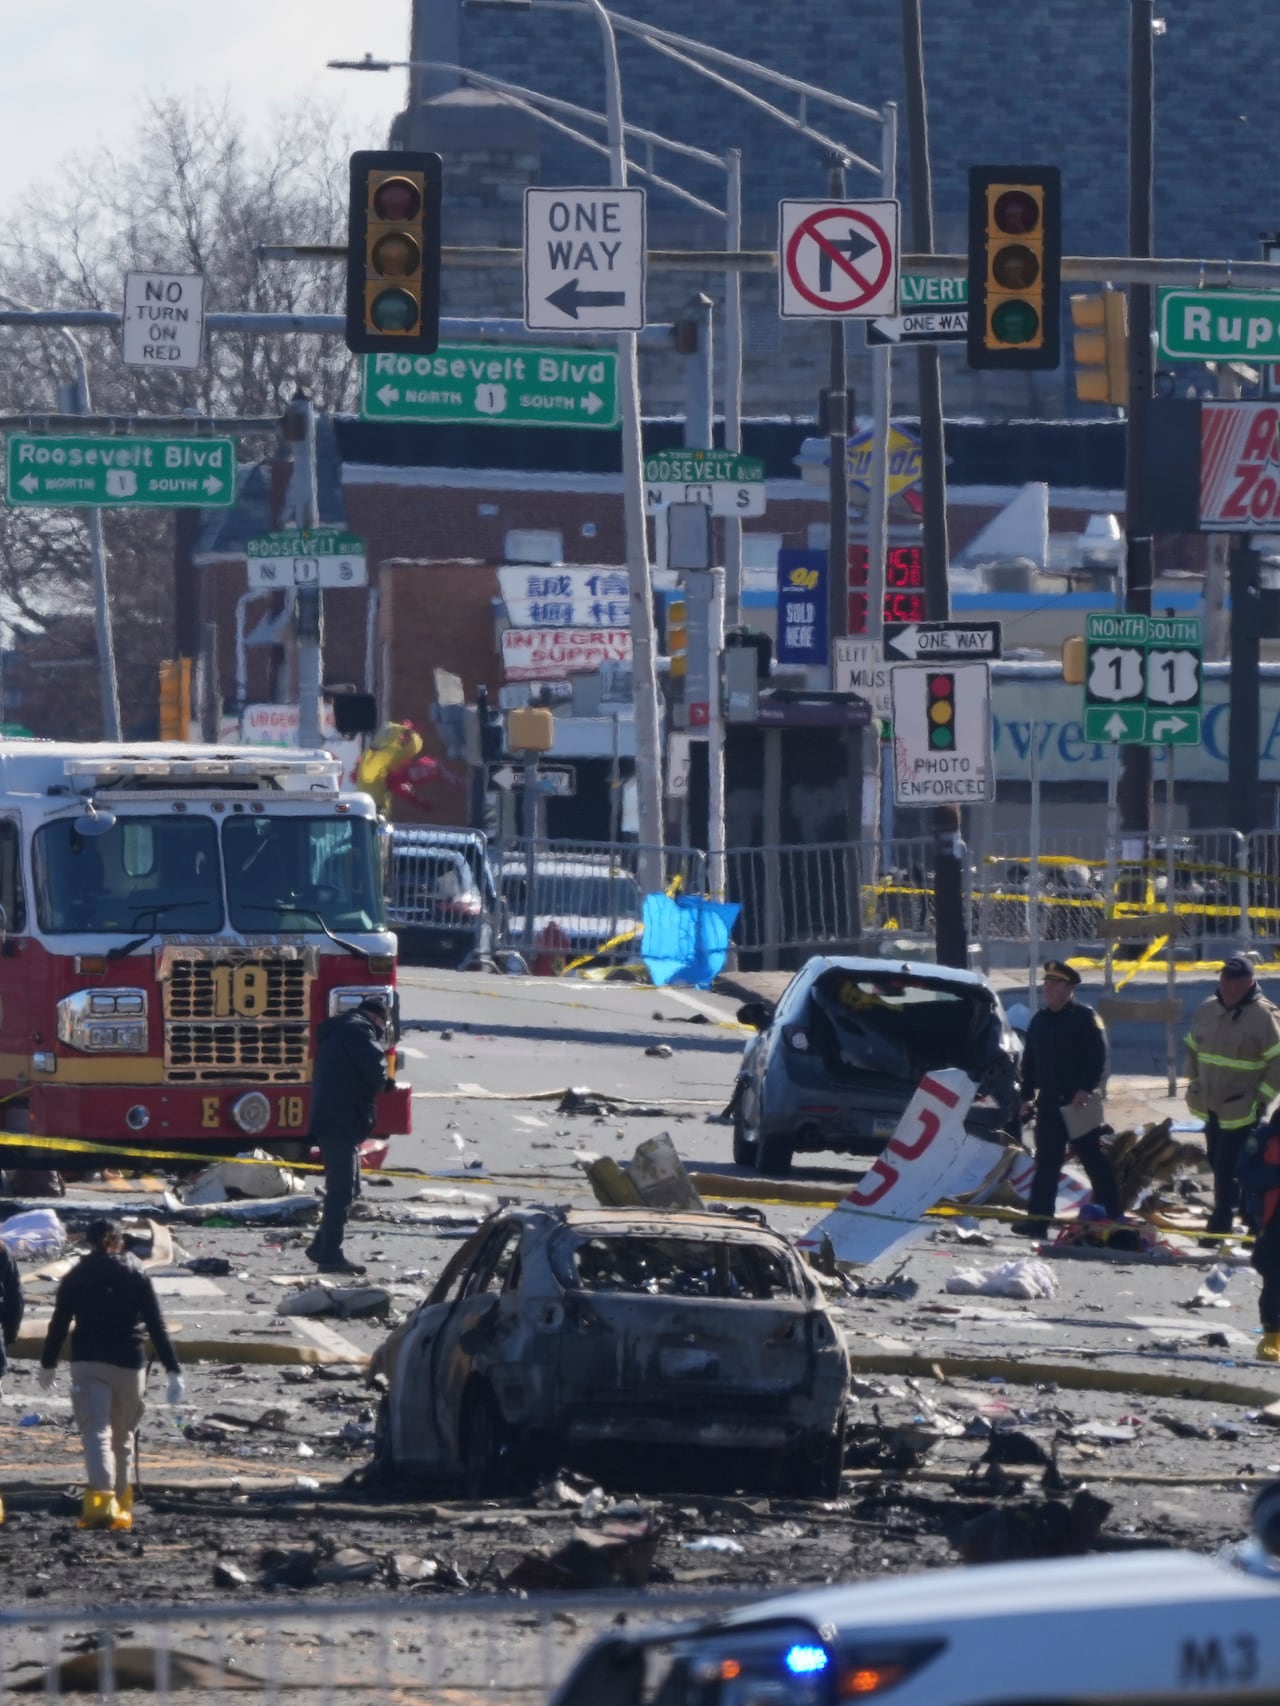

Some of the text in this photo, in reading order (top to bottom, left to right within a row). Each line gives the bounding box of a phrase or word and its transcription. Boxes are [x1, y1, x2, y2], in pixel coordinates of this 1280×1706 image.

[548, 201, 621, 233] ONE
[547, 241, 622, 271] WAY
[144, 279, 183, 304] NO
[900, 277, 967, 302] LVERT
[136, 305, 190, 322] TURN
[903, 315, 935, 332] ONE
[148, 323, 178, 342] ON
[1183, 305, 1280, 350] Rup
[143, 344, 182, 361] RED
[375, 352, 606, 384] Roosevelt Blvd
[405, 389, 462, 405] NORTH
[521, 393, 575, 410] SOUTH
[1241, 408, 1280, 462] A
[20, 443, 223, 468] Roosevelt Blvd
[646, 461, 733, 481] OOSEVELT
[45, 478, 95, 491] NORTH
[149, 478, 198, 491] SOUTH
[1219, 463, 1280, 519] Zo
[647, 489, 662, 506] N
[736, 489, 750, 508] S
[260, 563, 276, 580] N
[339, 561, 353, 581] S
[786, 602, 815, 623] SOLD
[1092, 618, 1144, 636] NORTH
[1149, 622, 1197, 639] SOUTH
[506, 631, 632, 648] INTEGRIT
[918, 632, 988, 650] ONE WAY
[531, 648, 627, 664] SUPPLY
[849, 669, 886, 688] MUS
[1108, 656, 1122, 690] 1
[1161, 659, 1175, 693] 1
[914, 757, 970, 773] PHOTO
[210, 965, 269, 1018] 18
[202, 1097, 220, 1128] E
[277, 1096, 304, 1128] 18
